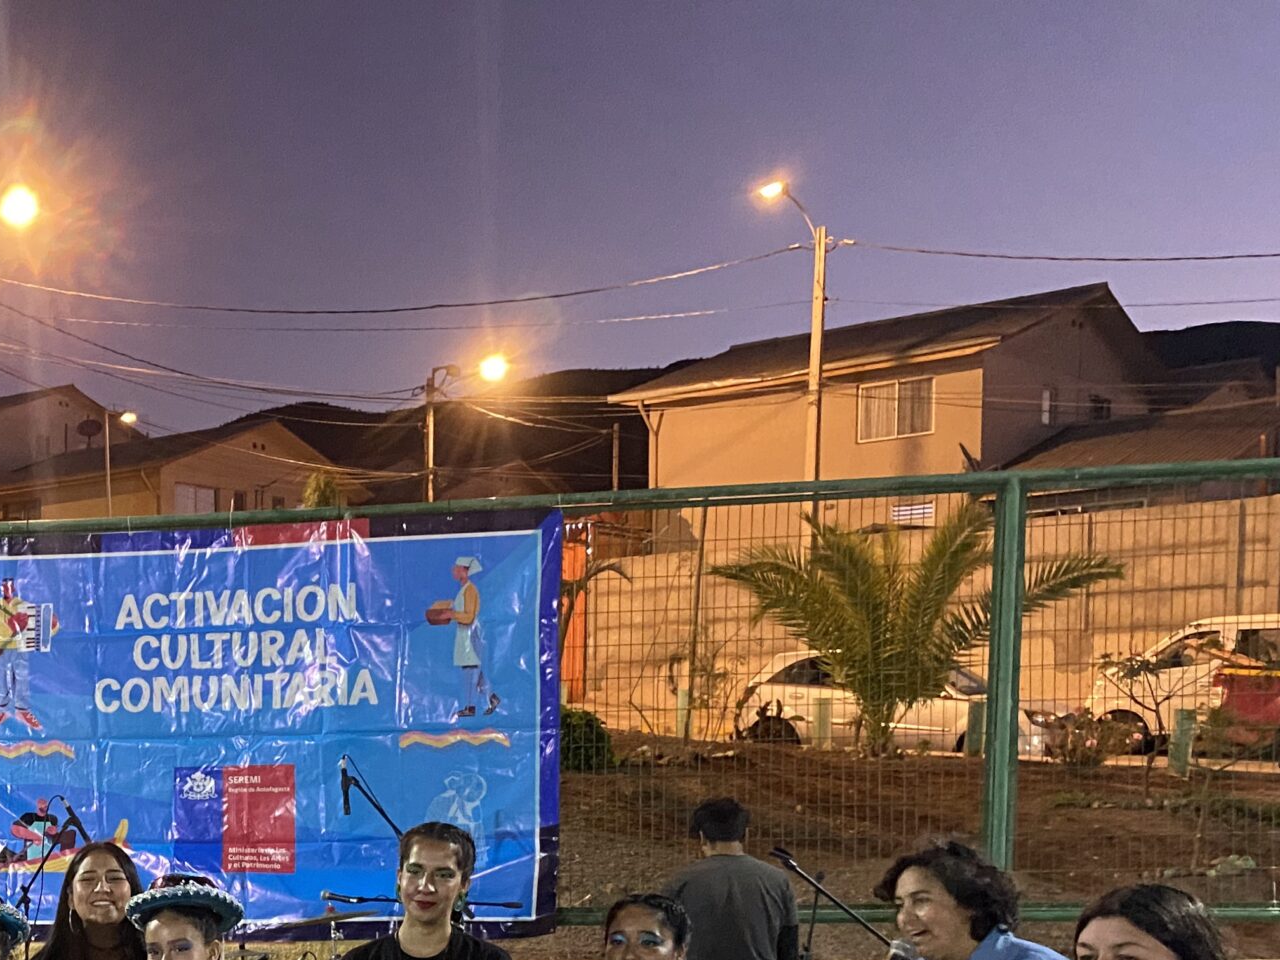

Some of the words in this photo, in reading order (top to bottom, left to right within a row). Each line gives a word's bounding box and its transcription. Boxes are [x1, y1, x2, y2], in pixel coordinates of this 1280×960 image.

[115, 574, 358, 630] ACTIVACIÓN
[133, 627, 337, 671] CULTURAL
[94, 668, 379, 713] COMUNITARIA
[228, 775, 261, 784] SEREMI
